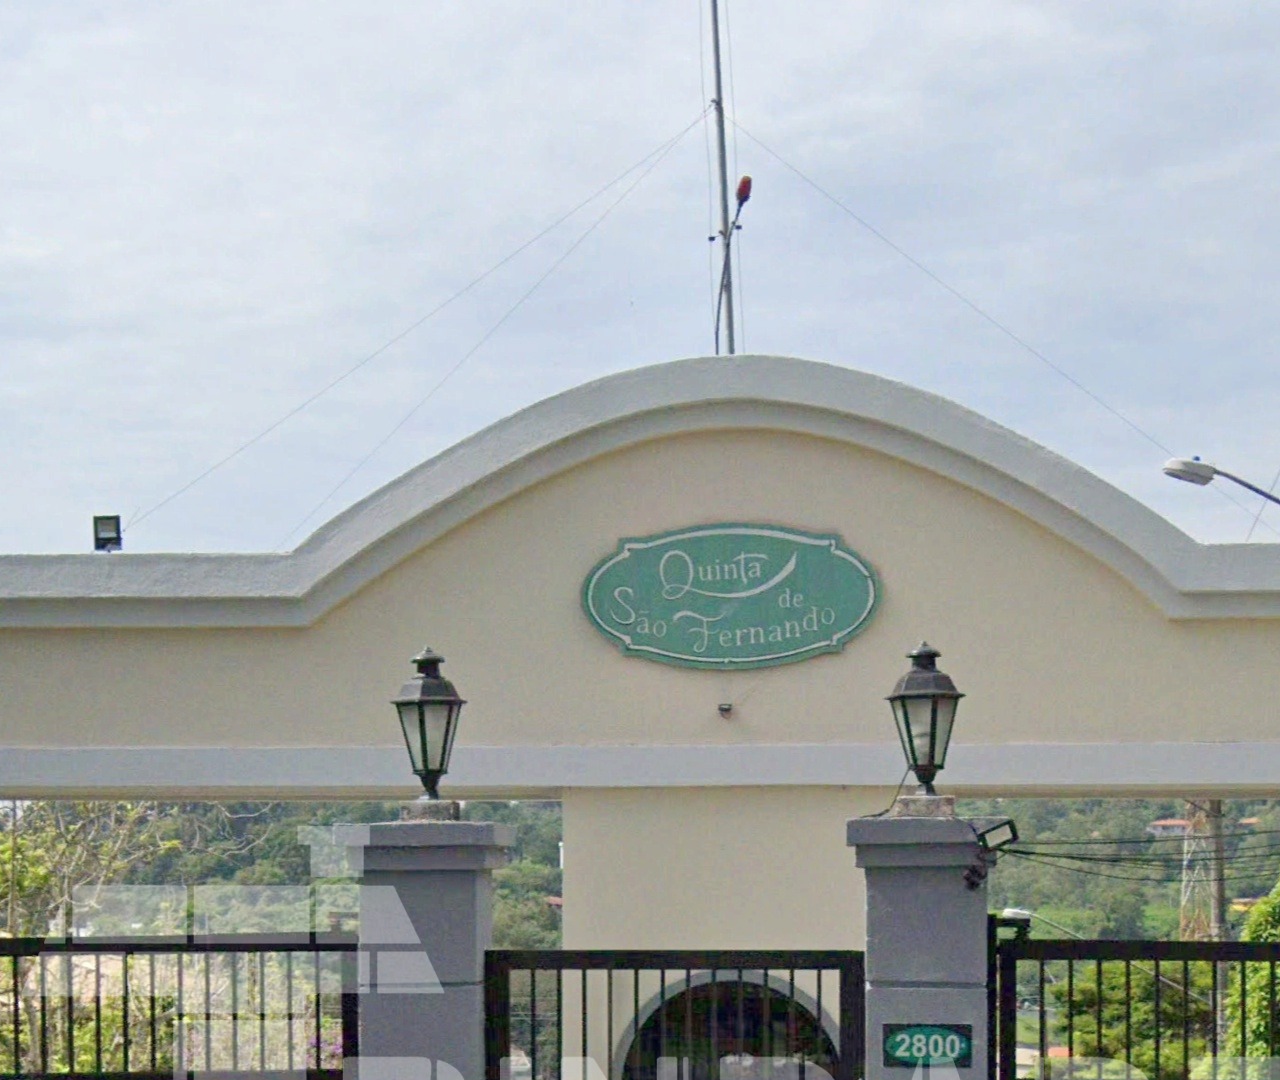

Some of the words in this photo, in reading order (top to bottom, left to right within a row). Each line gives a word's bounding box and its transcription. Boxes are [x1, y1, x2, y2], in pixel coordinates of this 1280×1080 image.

[659, 550, 797, 600] Quinta
[778, 588, 804, 608] de
[610, 587, 667, 638] São
[673, 607, 836, 652] Fernando
[894, 1033, 960, 1058] 2800
